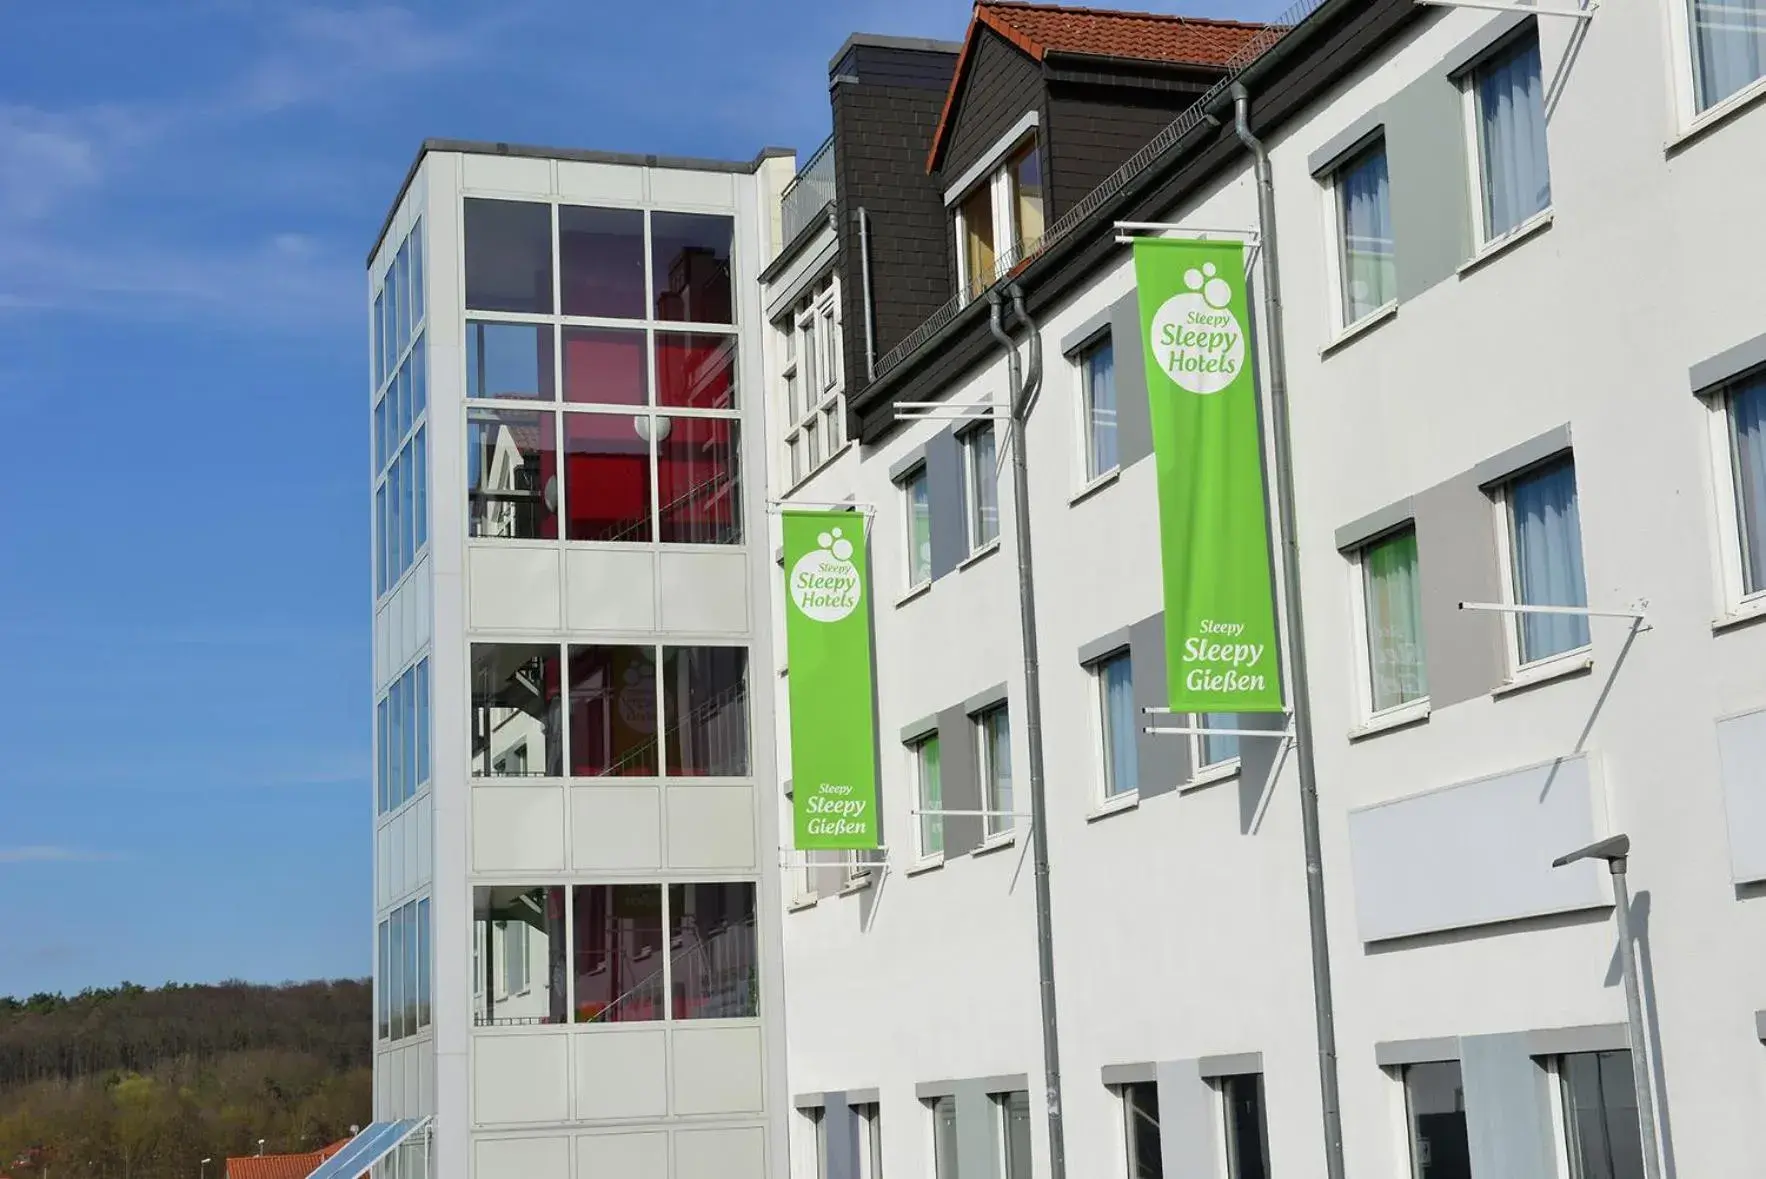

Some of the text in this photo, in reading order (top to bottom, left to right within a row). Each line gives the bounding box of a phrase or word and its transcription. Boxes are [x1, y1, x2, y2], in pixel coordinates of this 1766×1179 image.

[1187, 311, 1230, 328] Sleepy
[1160, 323, 1238, 353] Sleepy
[1168, 349, 1235, 374] Hotels
[797, 571, 856, 593] Sleepy
[801, 590, 854, 608] Hotels
[1199, 619, 1245, 637] Sleepy
[1182, 637, 1264, 667] Sleepy
[1186, 668, 1265, 693] Gießen
[818, 783, 853, 796] Sleepy
[805, 795, 866, 817] Sleepy
[808, 818, 866, 835] Gießen
